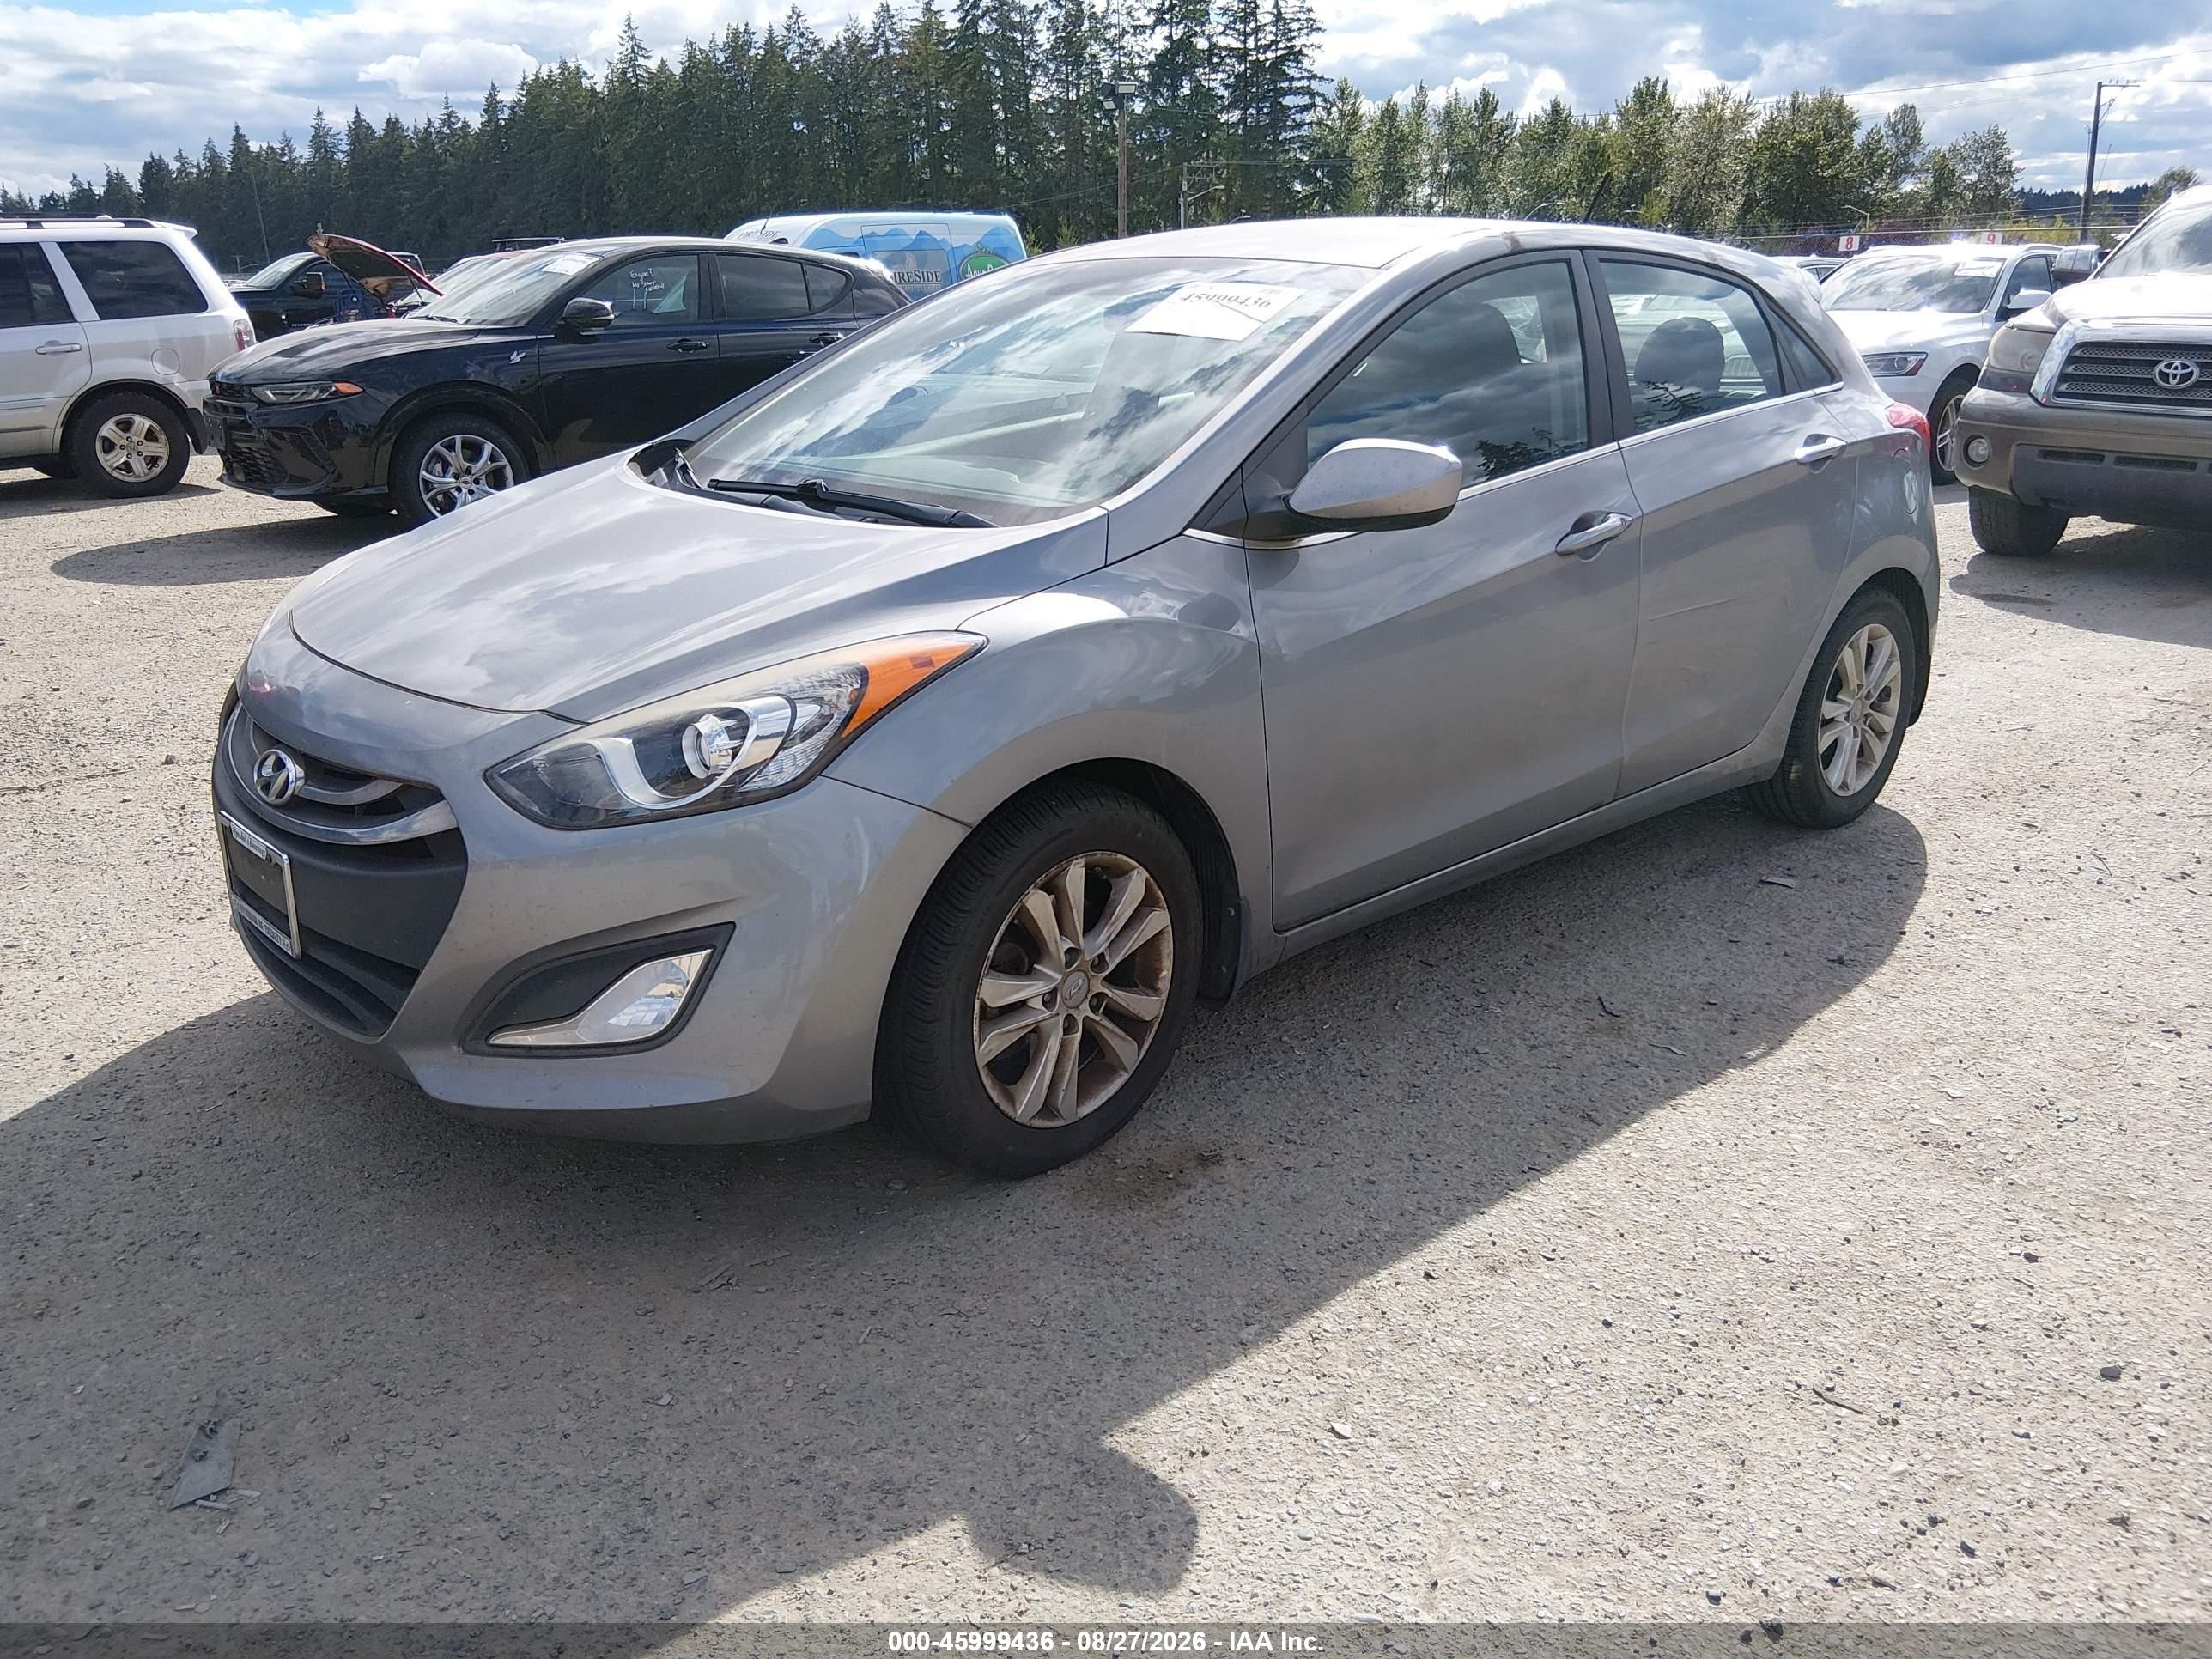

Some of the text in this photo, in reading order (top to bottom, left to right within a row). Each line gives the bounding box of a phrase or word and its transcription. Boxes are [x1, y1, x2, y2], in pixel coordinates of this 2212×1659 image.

[1845, 236, 1854, 250] 8
[1986, 233, 1996, 244] 9
[891, 269, 942, 283] IRESIDE
